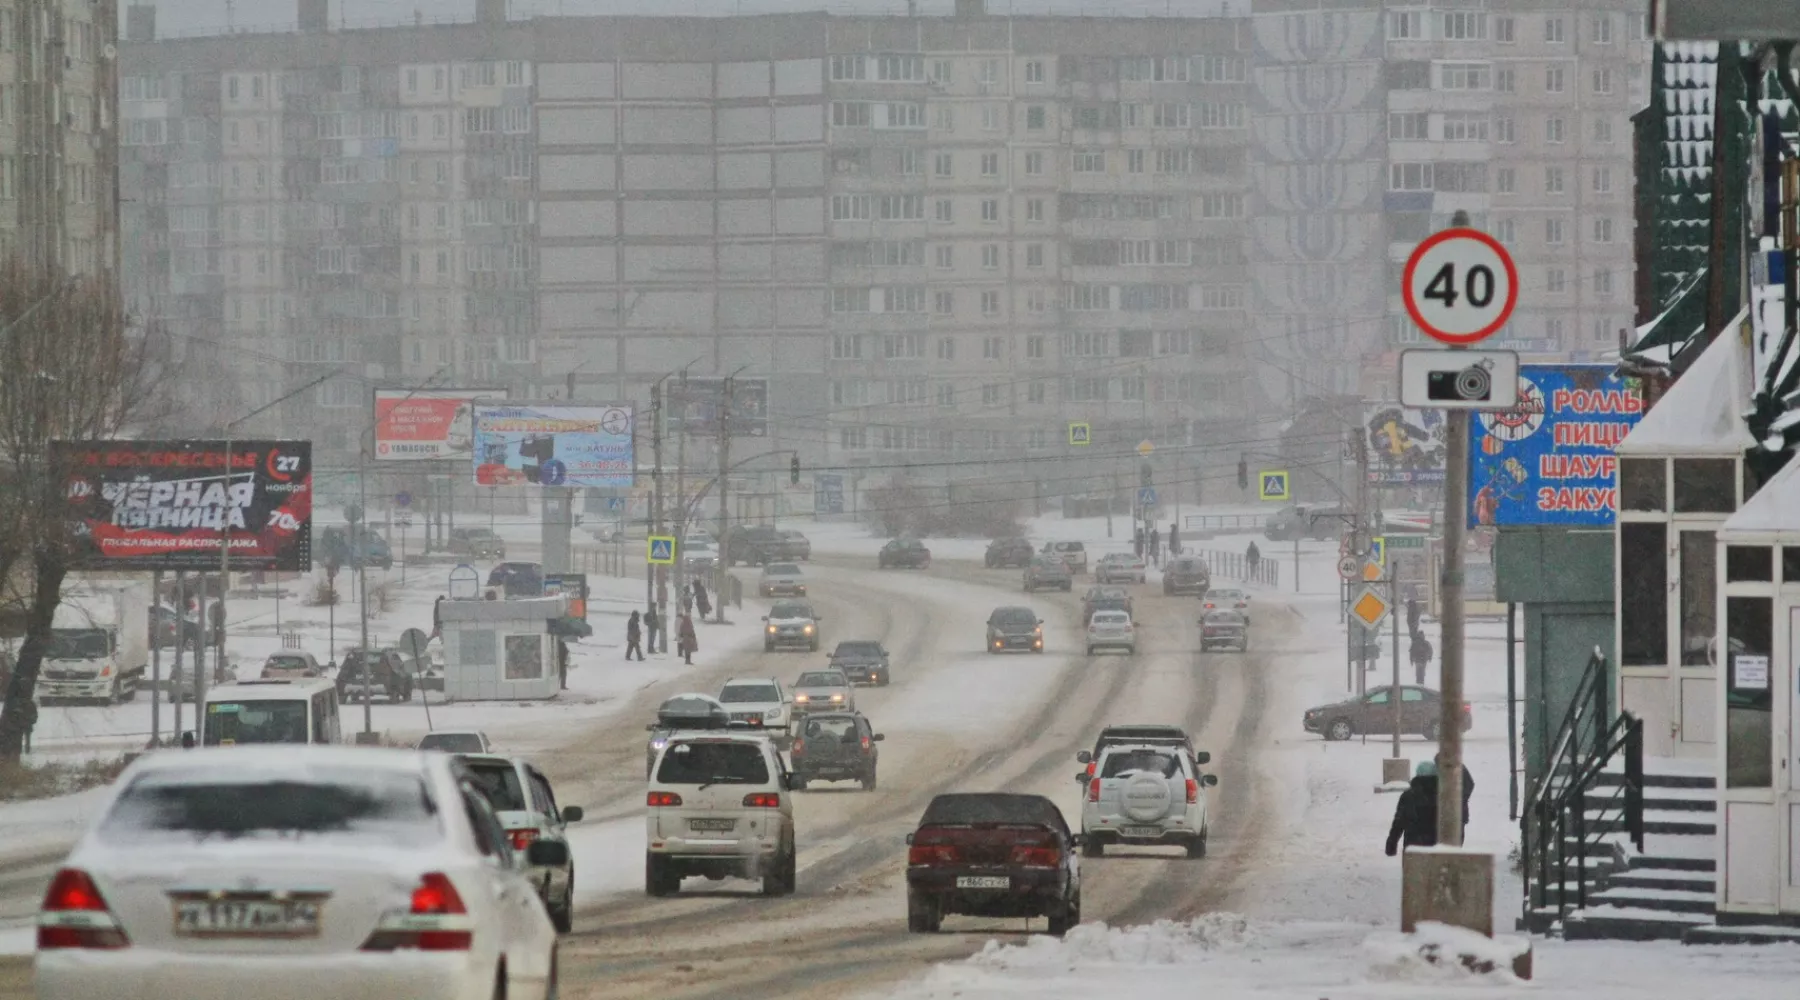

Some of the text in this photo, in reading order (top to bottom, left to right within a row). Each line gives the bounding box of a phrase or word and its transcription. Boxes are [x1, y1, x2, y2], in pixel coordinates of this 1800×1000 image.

[1423, 261, 1495, 309] 40
[391, 444, 440, 453] YAMAGUCHI
[276, 456, 300, 472] 27
[101, 475, 255, 508] ЧЁРНАЯ
[265, 483, 307, 493] ноября
[111, 506, 246, 531] ПЯТНИЦА
